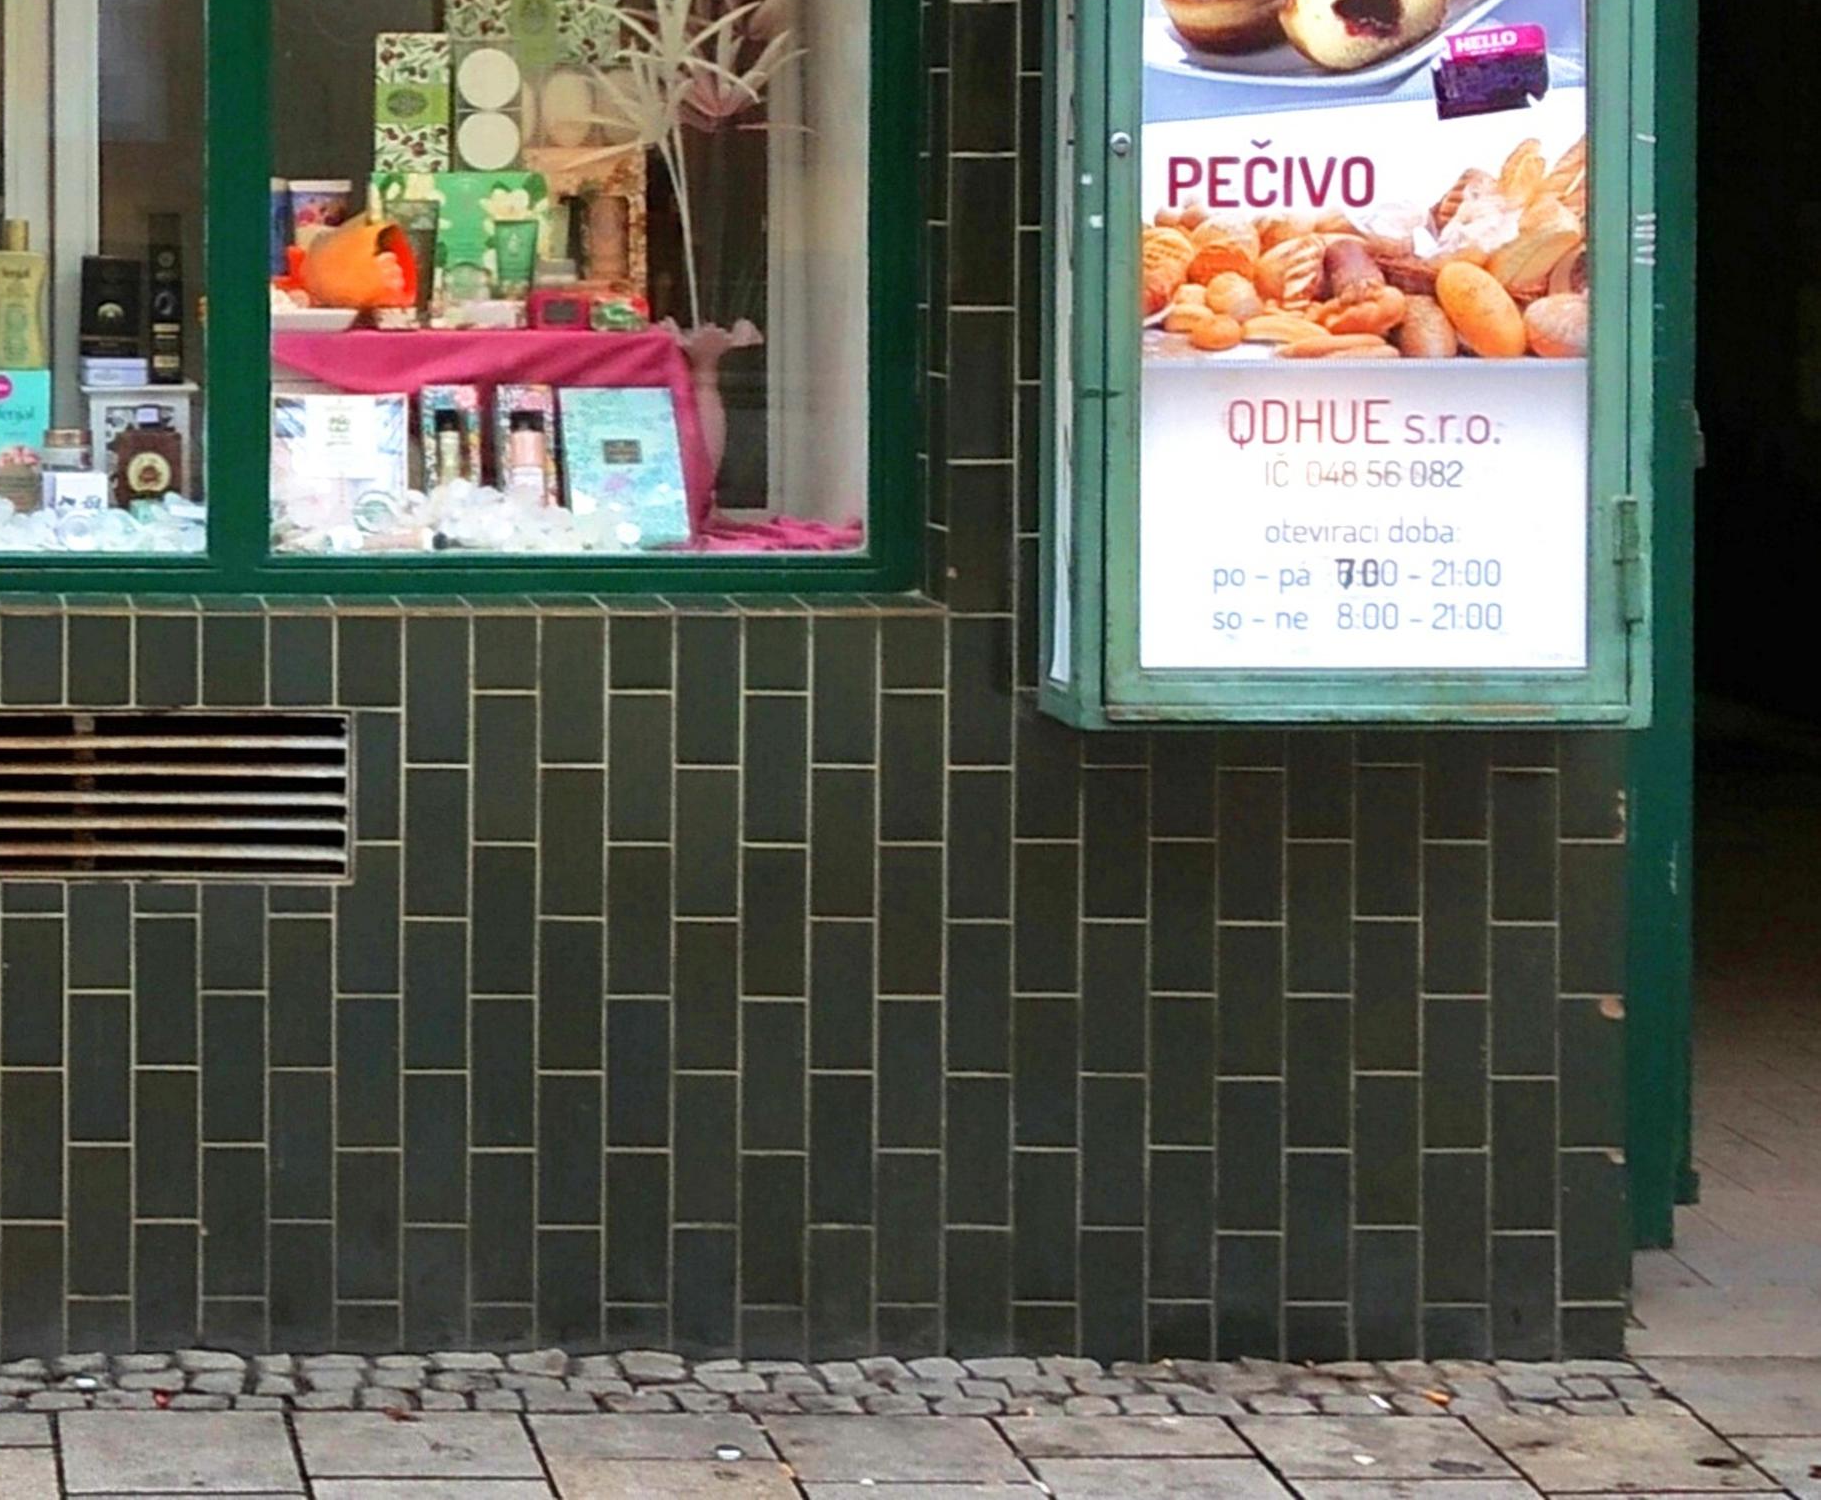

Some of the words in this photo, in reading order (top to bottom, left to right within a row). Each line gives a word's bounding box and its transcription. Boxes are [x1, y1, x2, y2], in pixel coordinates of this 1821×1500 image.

[1455, 30, 1518, 53] HELLO
[1168, 140, 1375, 209] PEČIVO
[1404, 414, 1502, 446] s.r.o.
[1306, 460, 1359, 489] 048
[1366, 460, 1403, 489] 56
[1409, 460, 1465, 489] 082
[1213, 567, 1246, 594] po
[1430, 558, 1502, 588] 21:00
[1212, 611, 1243, 631] so
[1275, 611, 1309, 631] ne
[1336, 602, 1399, 631] 8:00
[1431, 602, 1503, 631] 21:00
